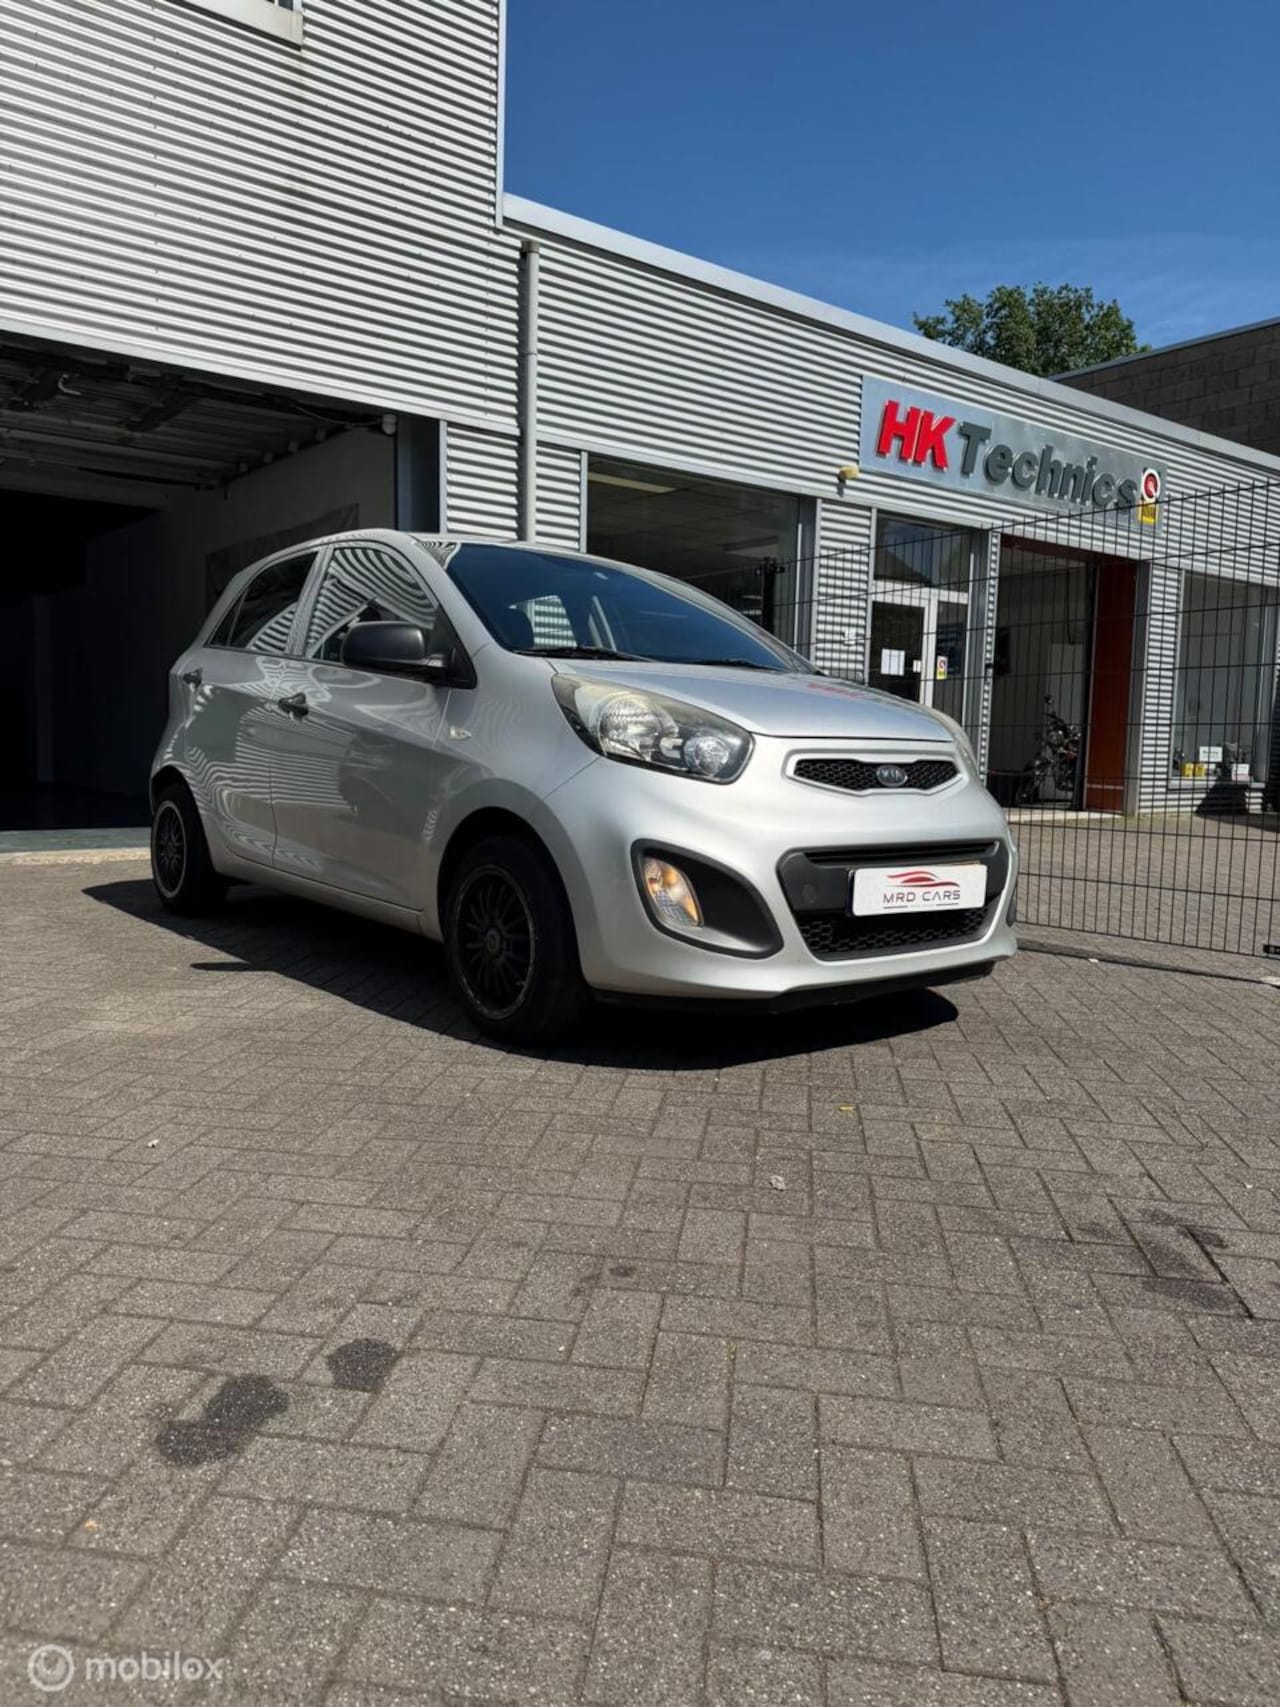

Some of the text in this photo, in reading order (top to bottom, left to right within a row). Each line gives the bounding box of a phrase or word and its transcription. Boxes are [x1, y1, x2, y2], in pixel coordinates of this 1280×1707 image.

[877, 400, 1138, 513] HK Technics
[883, 890, 961, 903] MRD CARS
